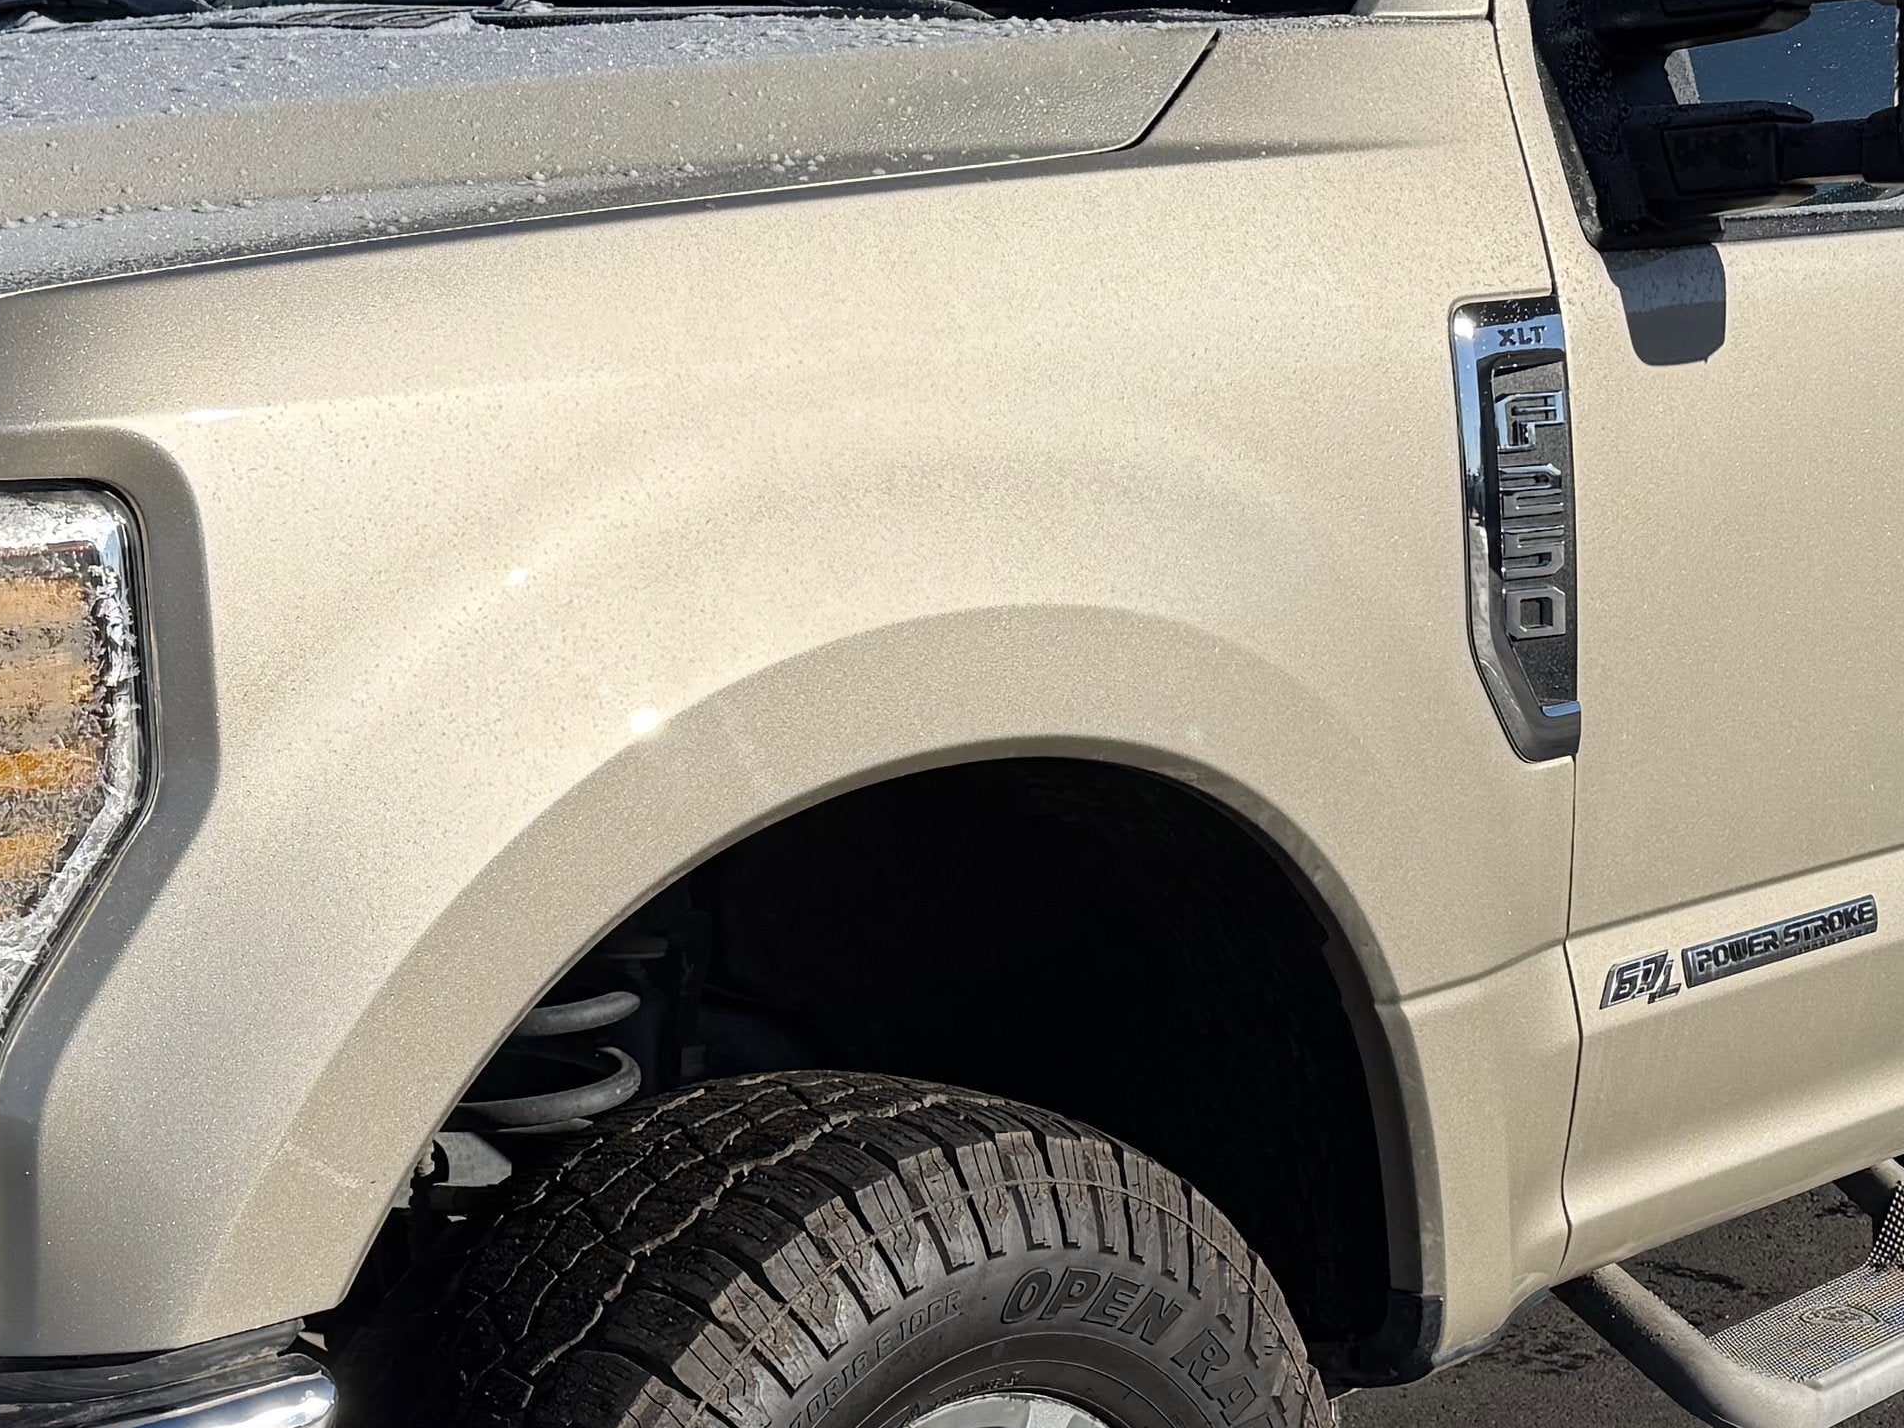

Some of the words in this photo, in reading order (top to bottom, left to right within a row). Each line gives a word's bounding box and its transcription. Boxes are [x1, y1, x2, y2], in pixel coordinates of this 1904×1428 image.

[1498, 325, 1547, 347] XLT
[1494, 390, 1566, 642] F250
[1696, 929, 1781, 973] POWER
[1783, 899, 1876, 948] STROKE
[1001, 1267, 1188, 1346] OPEN
